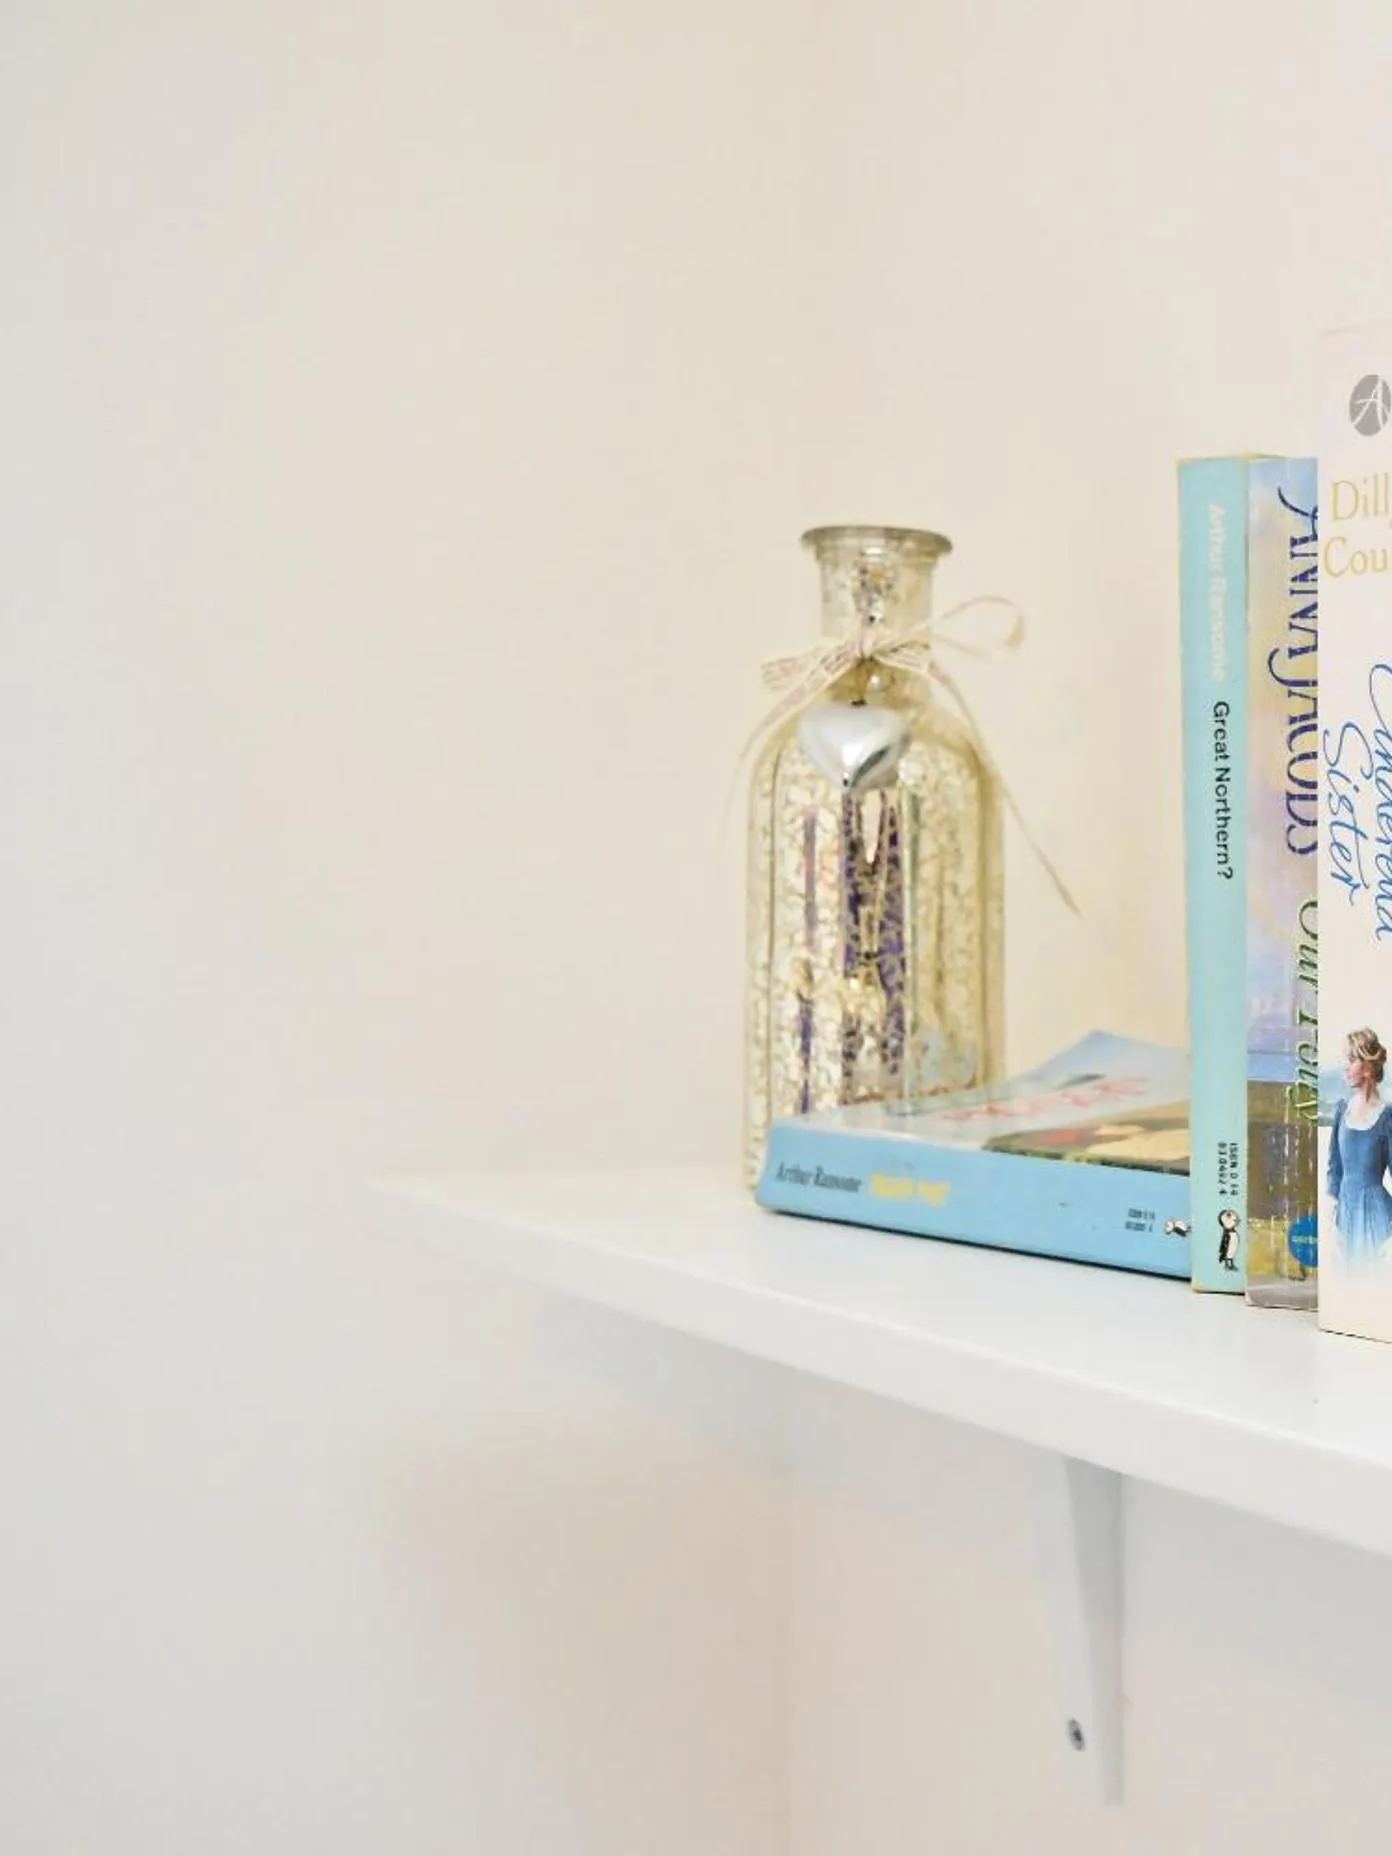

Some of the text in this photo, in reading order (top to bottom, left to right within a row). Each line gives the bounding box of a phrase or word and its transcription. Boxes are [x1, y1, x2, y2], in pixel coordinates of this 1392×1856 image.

[1213, 700, 1234, 880] Great Northern?
[1323, 721, 1374, 906] Sister
